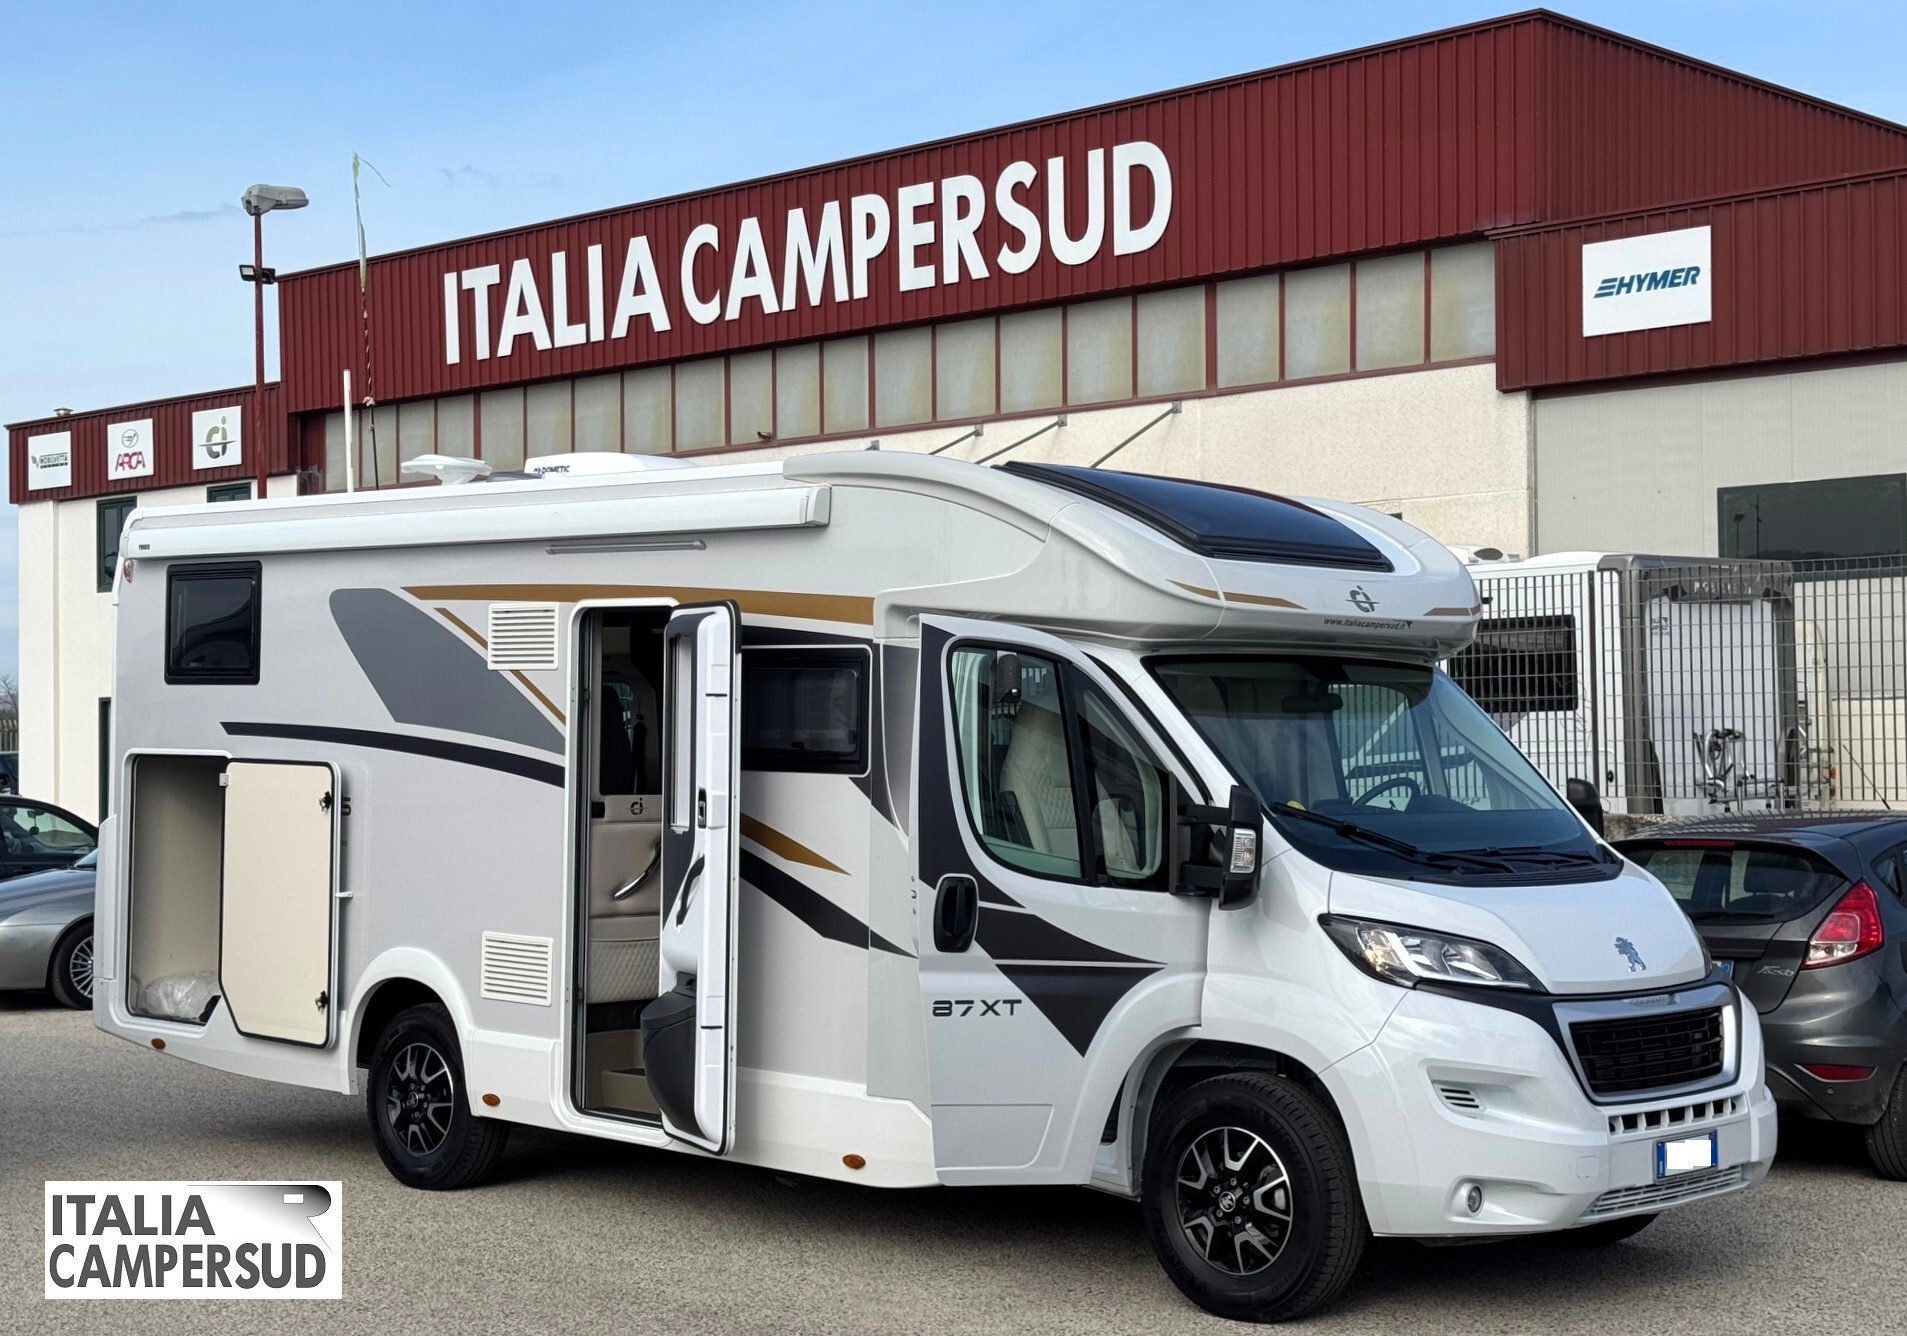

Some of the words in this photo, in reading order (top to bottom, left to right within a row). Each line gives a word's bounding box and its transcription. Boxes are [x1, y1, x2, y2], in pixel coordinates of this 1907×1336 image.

[444, 235, 671, 365] ITALIA
[681, 141, 1172, 325] CAMPERSUD
[1614, 265, 1701, 295] HYMER
[115, 450, 146, 472] ARCA
[541, 465, 571, 474] DOMETIC
[1323, 618, 1406, 630] www.italiacampersud.it
